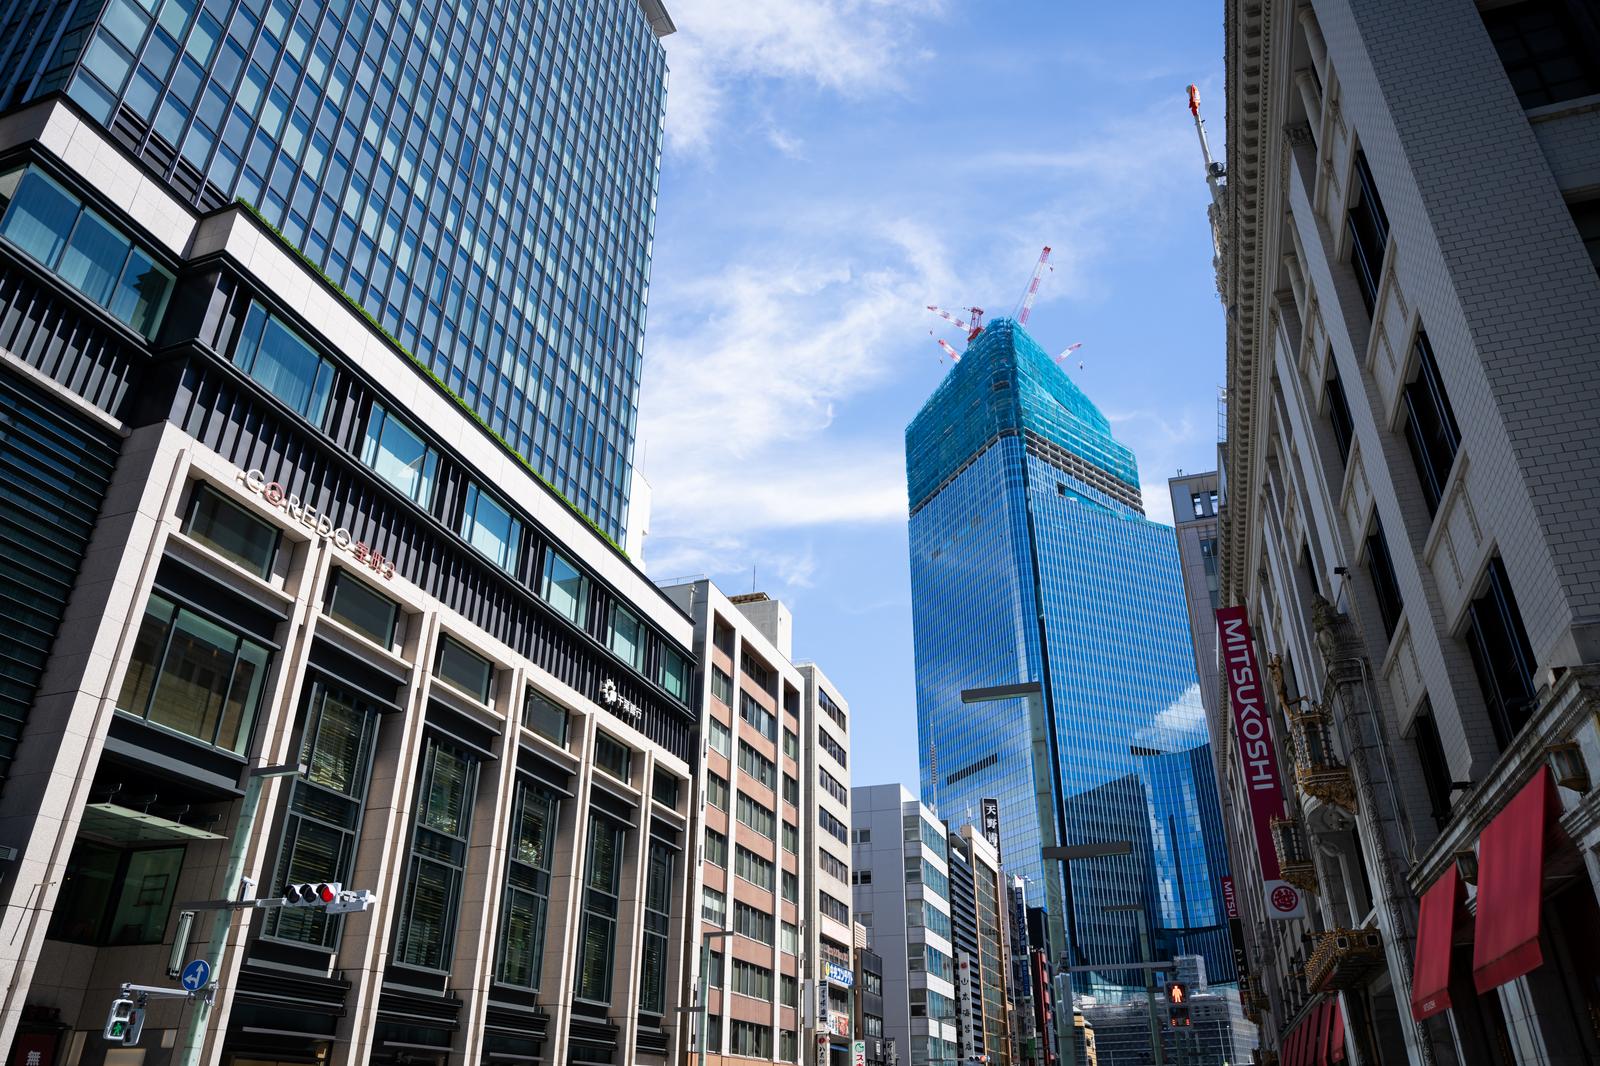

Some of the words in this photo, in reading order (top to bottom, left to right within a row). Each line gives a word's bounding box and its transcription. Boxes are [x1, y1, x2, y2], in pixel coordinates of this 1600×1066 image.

[1223, 618, 1274, 790] MITSUKOSHI
[960, 978, 972, 1051] 山本海苔店
